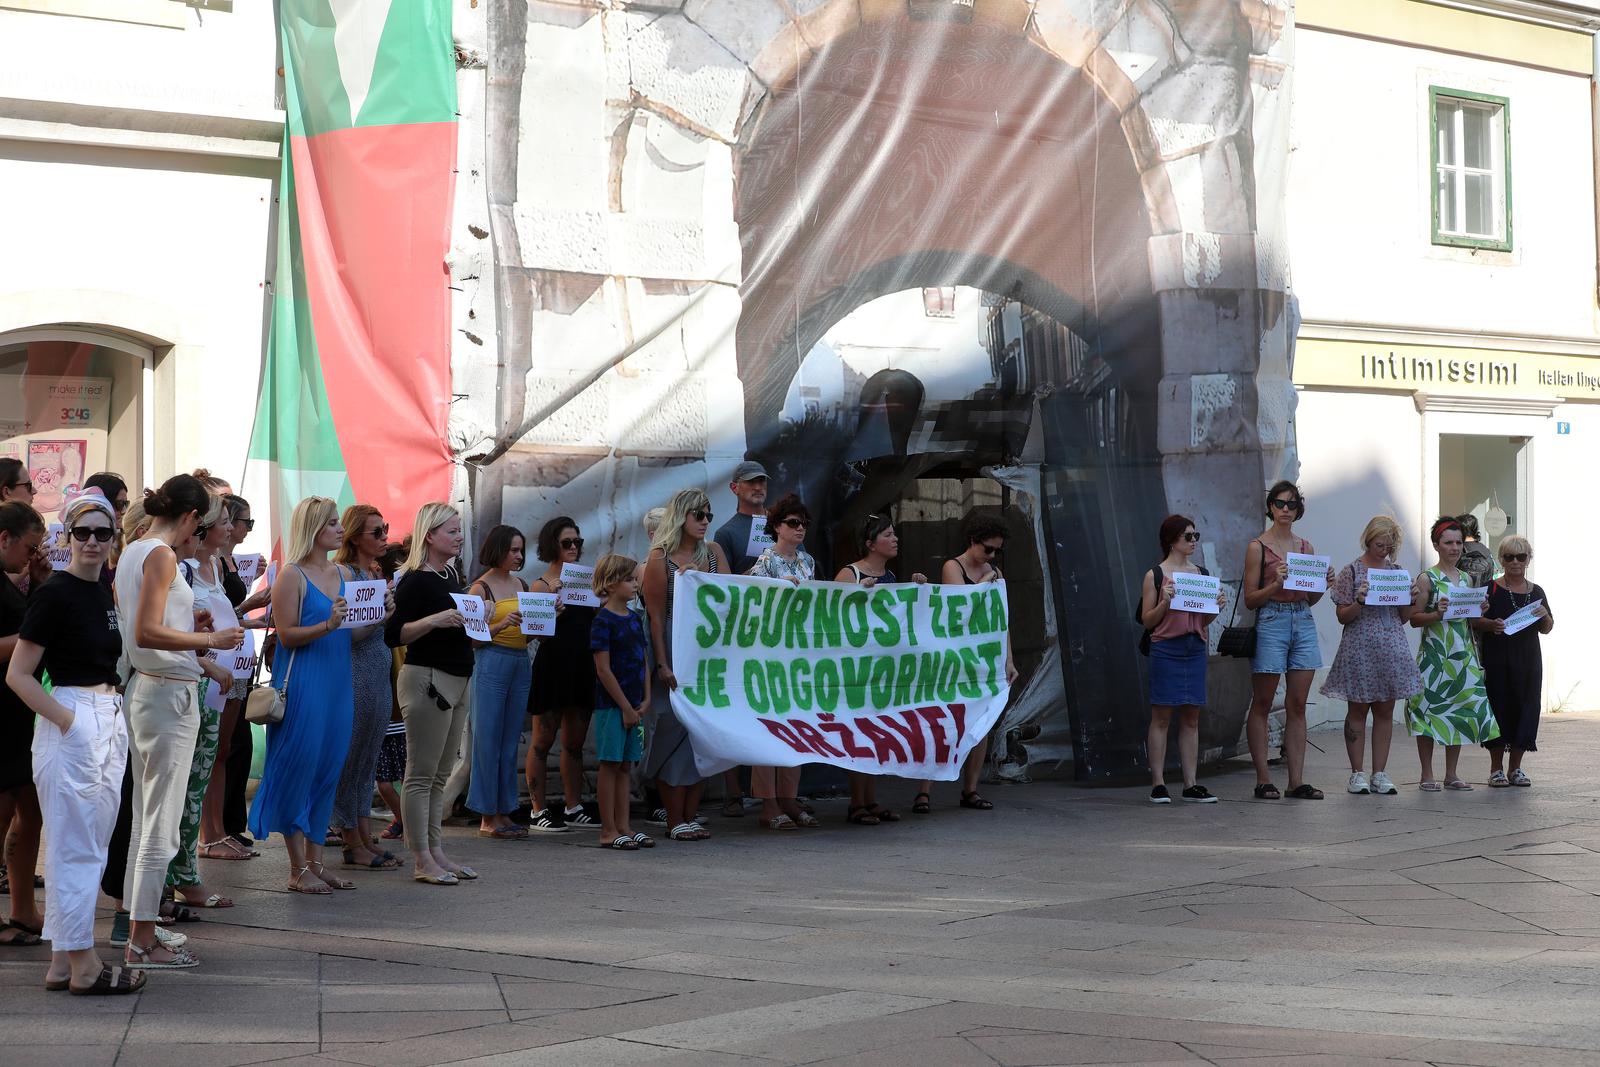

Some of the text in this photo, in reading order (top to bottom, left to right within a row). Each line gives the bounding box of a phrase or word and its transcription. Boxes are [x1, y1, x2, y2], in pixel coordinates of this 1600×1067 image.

[1539, 369, 1573, 386] Italian
[49, 385, 77, 394] make
[61, 408, 90, 420] 3C4G
[238, 559, 253, 571] STOP
[1176, 577, 1204, 587] SIGURNOST
[355, 587, 376, 602] STOP
[462, 599, 478, 613] STOP
[695, 583, 919, 649] SIGURNOST
[683, 641, 1002, 714] JE ODGOVORNOST
[756, 704, 967, 765] DRŽAVE!
